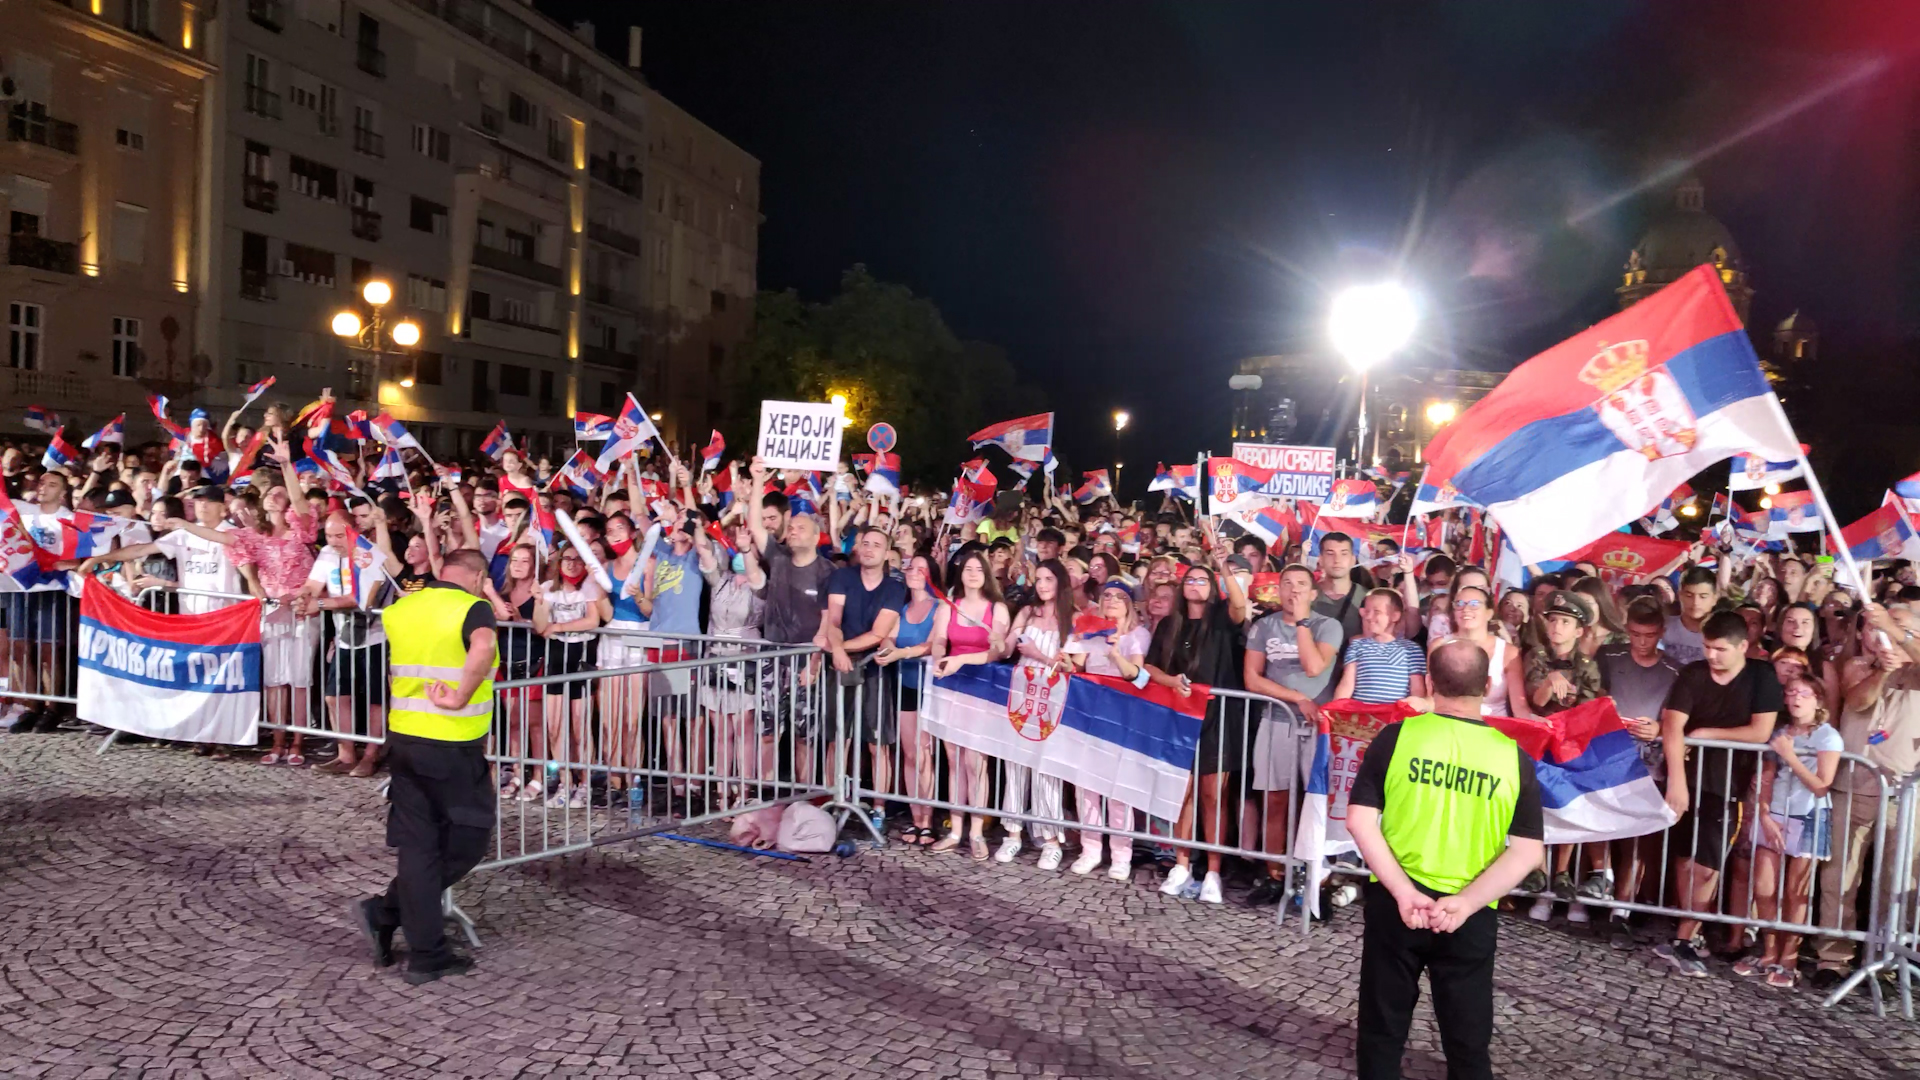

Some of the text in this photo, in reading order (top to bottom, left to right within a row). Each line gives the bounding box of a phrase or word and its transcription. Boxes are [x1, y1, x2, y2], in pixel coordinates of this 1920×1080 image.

[767, 413, 835, 438] ХЕРОЈИ
[764, 437, 832, 462] НАЦИЈЕ
[1260, 473, 1331, 496] ПУБЛИКЕ
[187, 652, 245, 691] ГРАД
[1408, 757, 1501, 800] SECURITY
